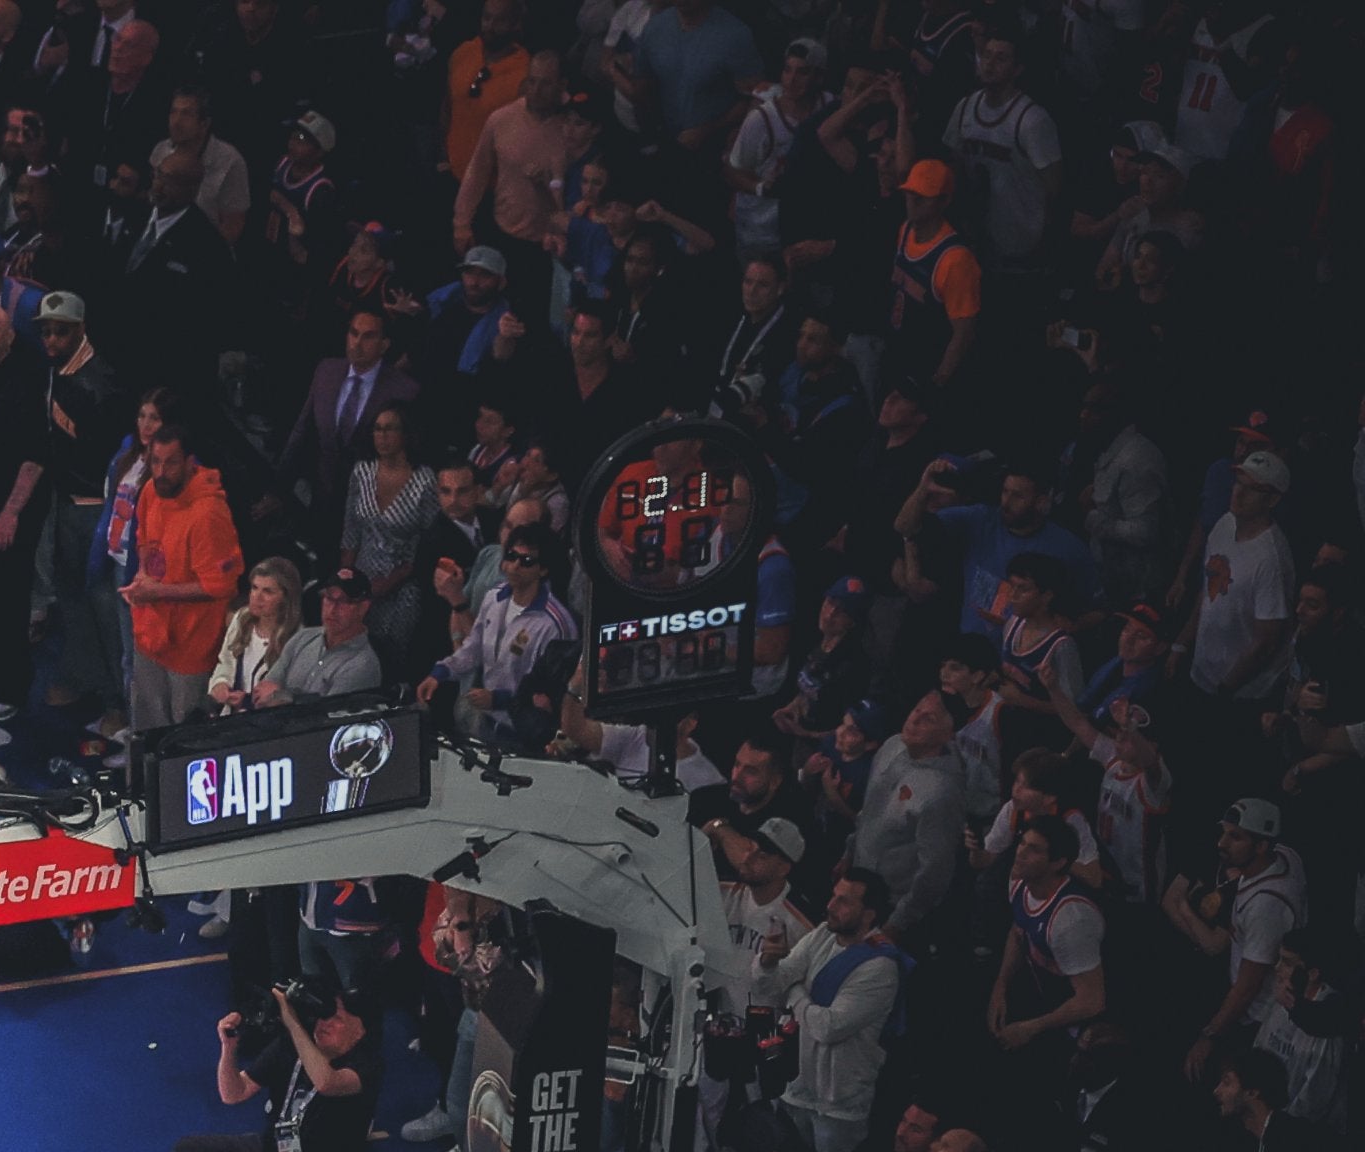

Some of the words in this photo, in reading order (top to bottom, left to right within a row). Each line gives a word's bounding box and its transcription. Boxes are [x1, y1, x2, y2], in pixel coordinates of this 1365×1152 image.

[644, 471, 707, 517] 2.1
[641, 603, 747, 638] TISSOT
[222, 754, 293, 825] App
[531, 1069, 583, 1112] GET
